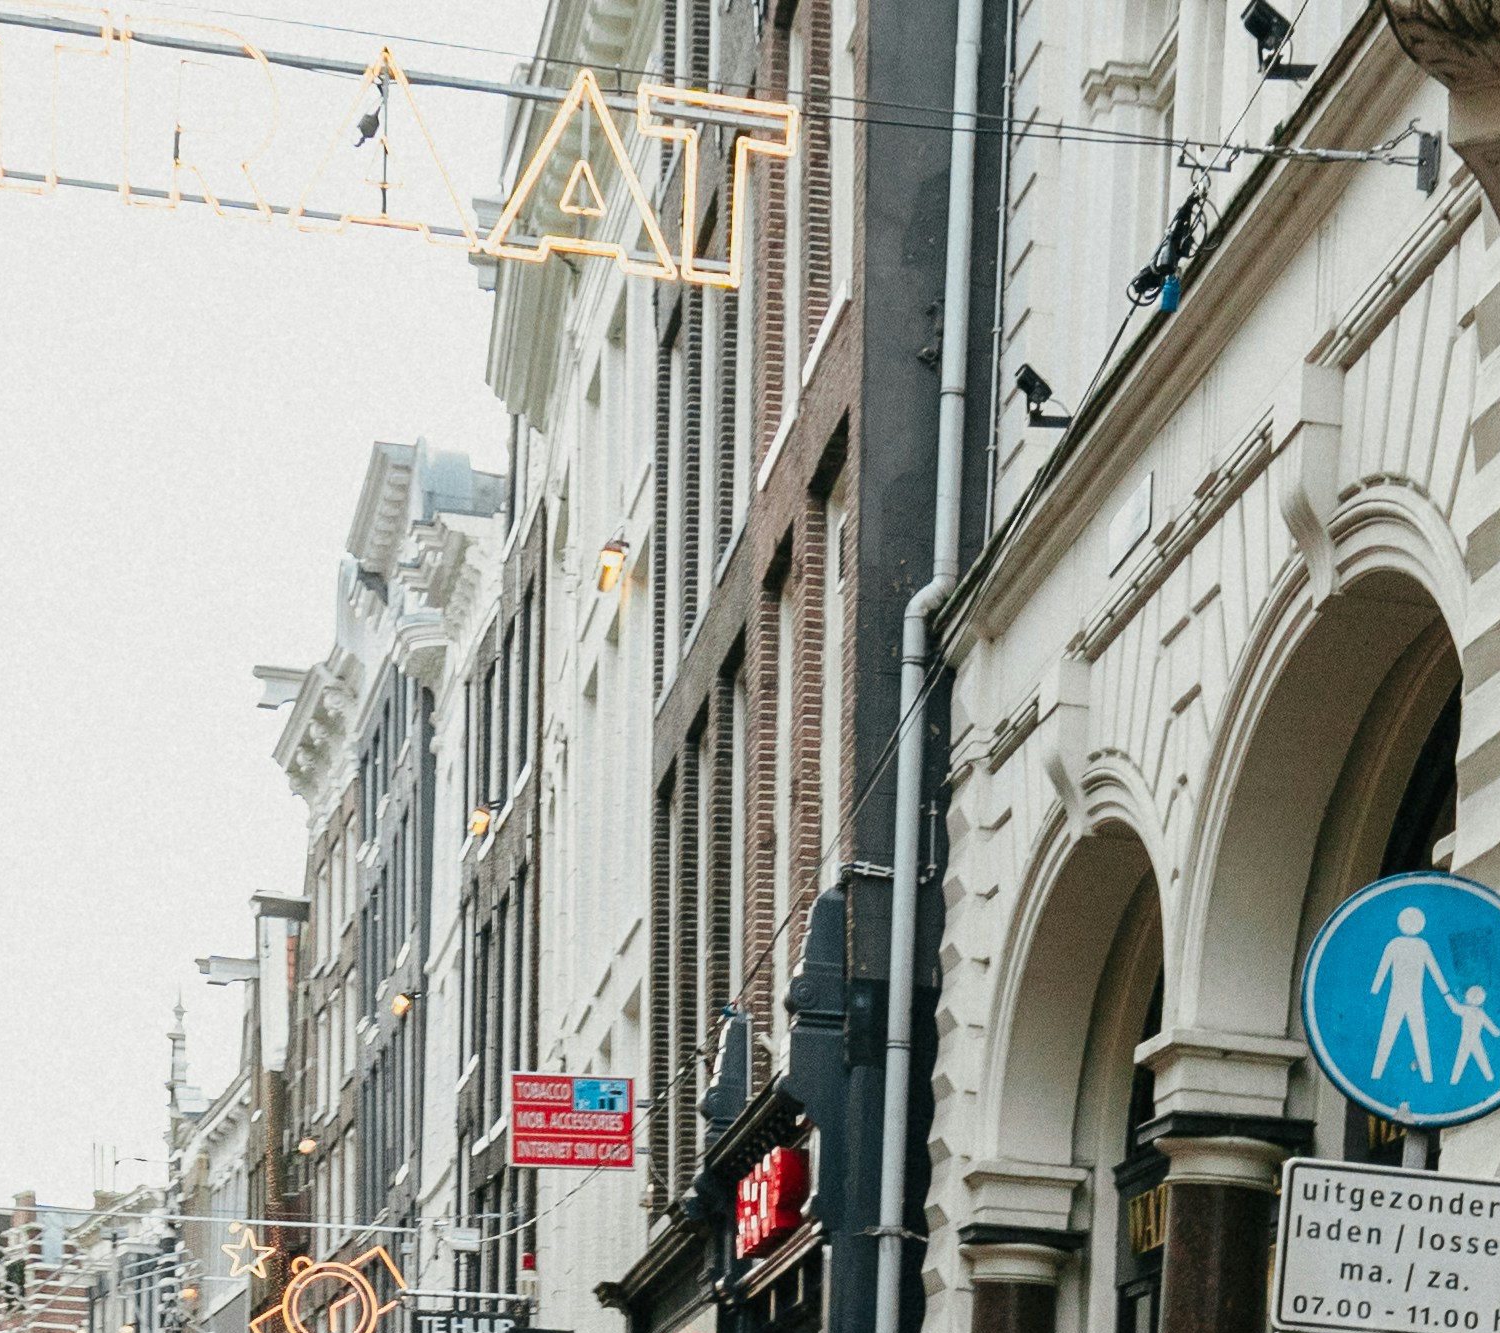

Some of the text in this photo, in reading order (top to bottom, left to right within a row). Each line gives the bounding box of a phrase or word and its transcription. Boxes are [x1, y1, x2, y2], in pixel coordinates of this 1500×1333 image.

[515, 1082, 571, 1100] TOBACCO
[516, 1141, 573, 1159] INTERNET
[1294, 1214, 1383, 1246] laden
[1395, 1224, 1405, 1254] /
[1339, 1261, 1393, 1285] ma.
[1427, 1270, 1470, 1292] za.
[1292, 1294, 1372, 1320] 07.00
[1406, 1305, 1479, 1330] 11.00
